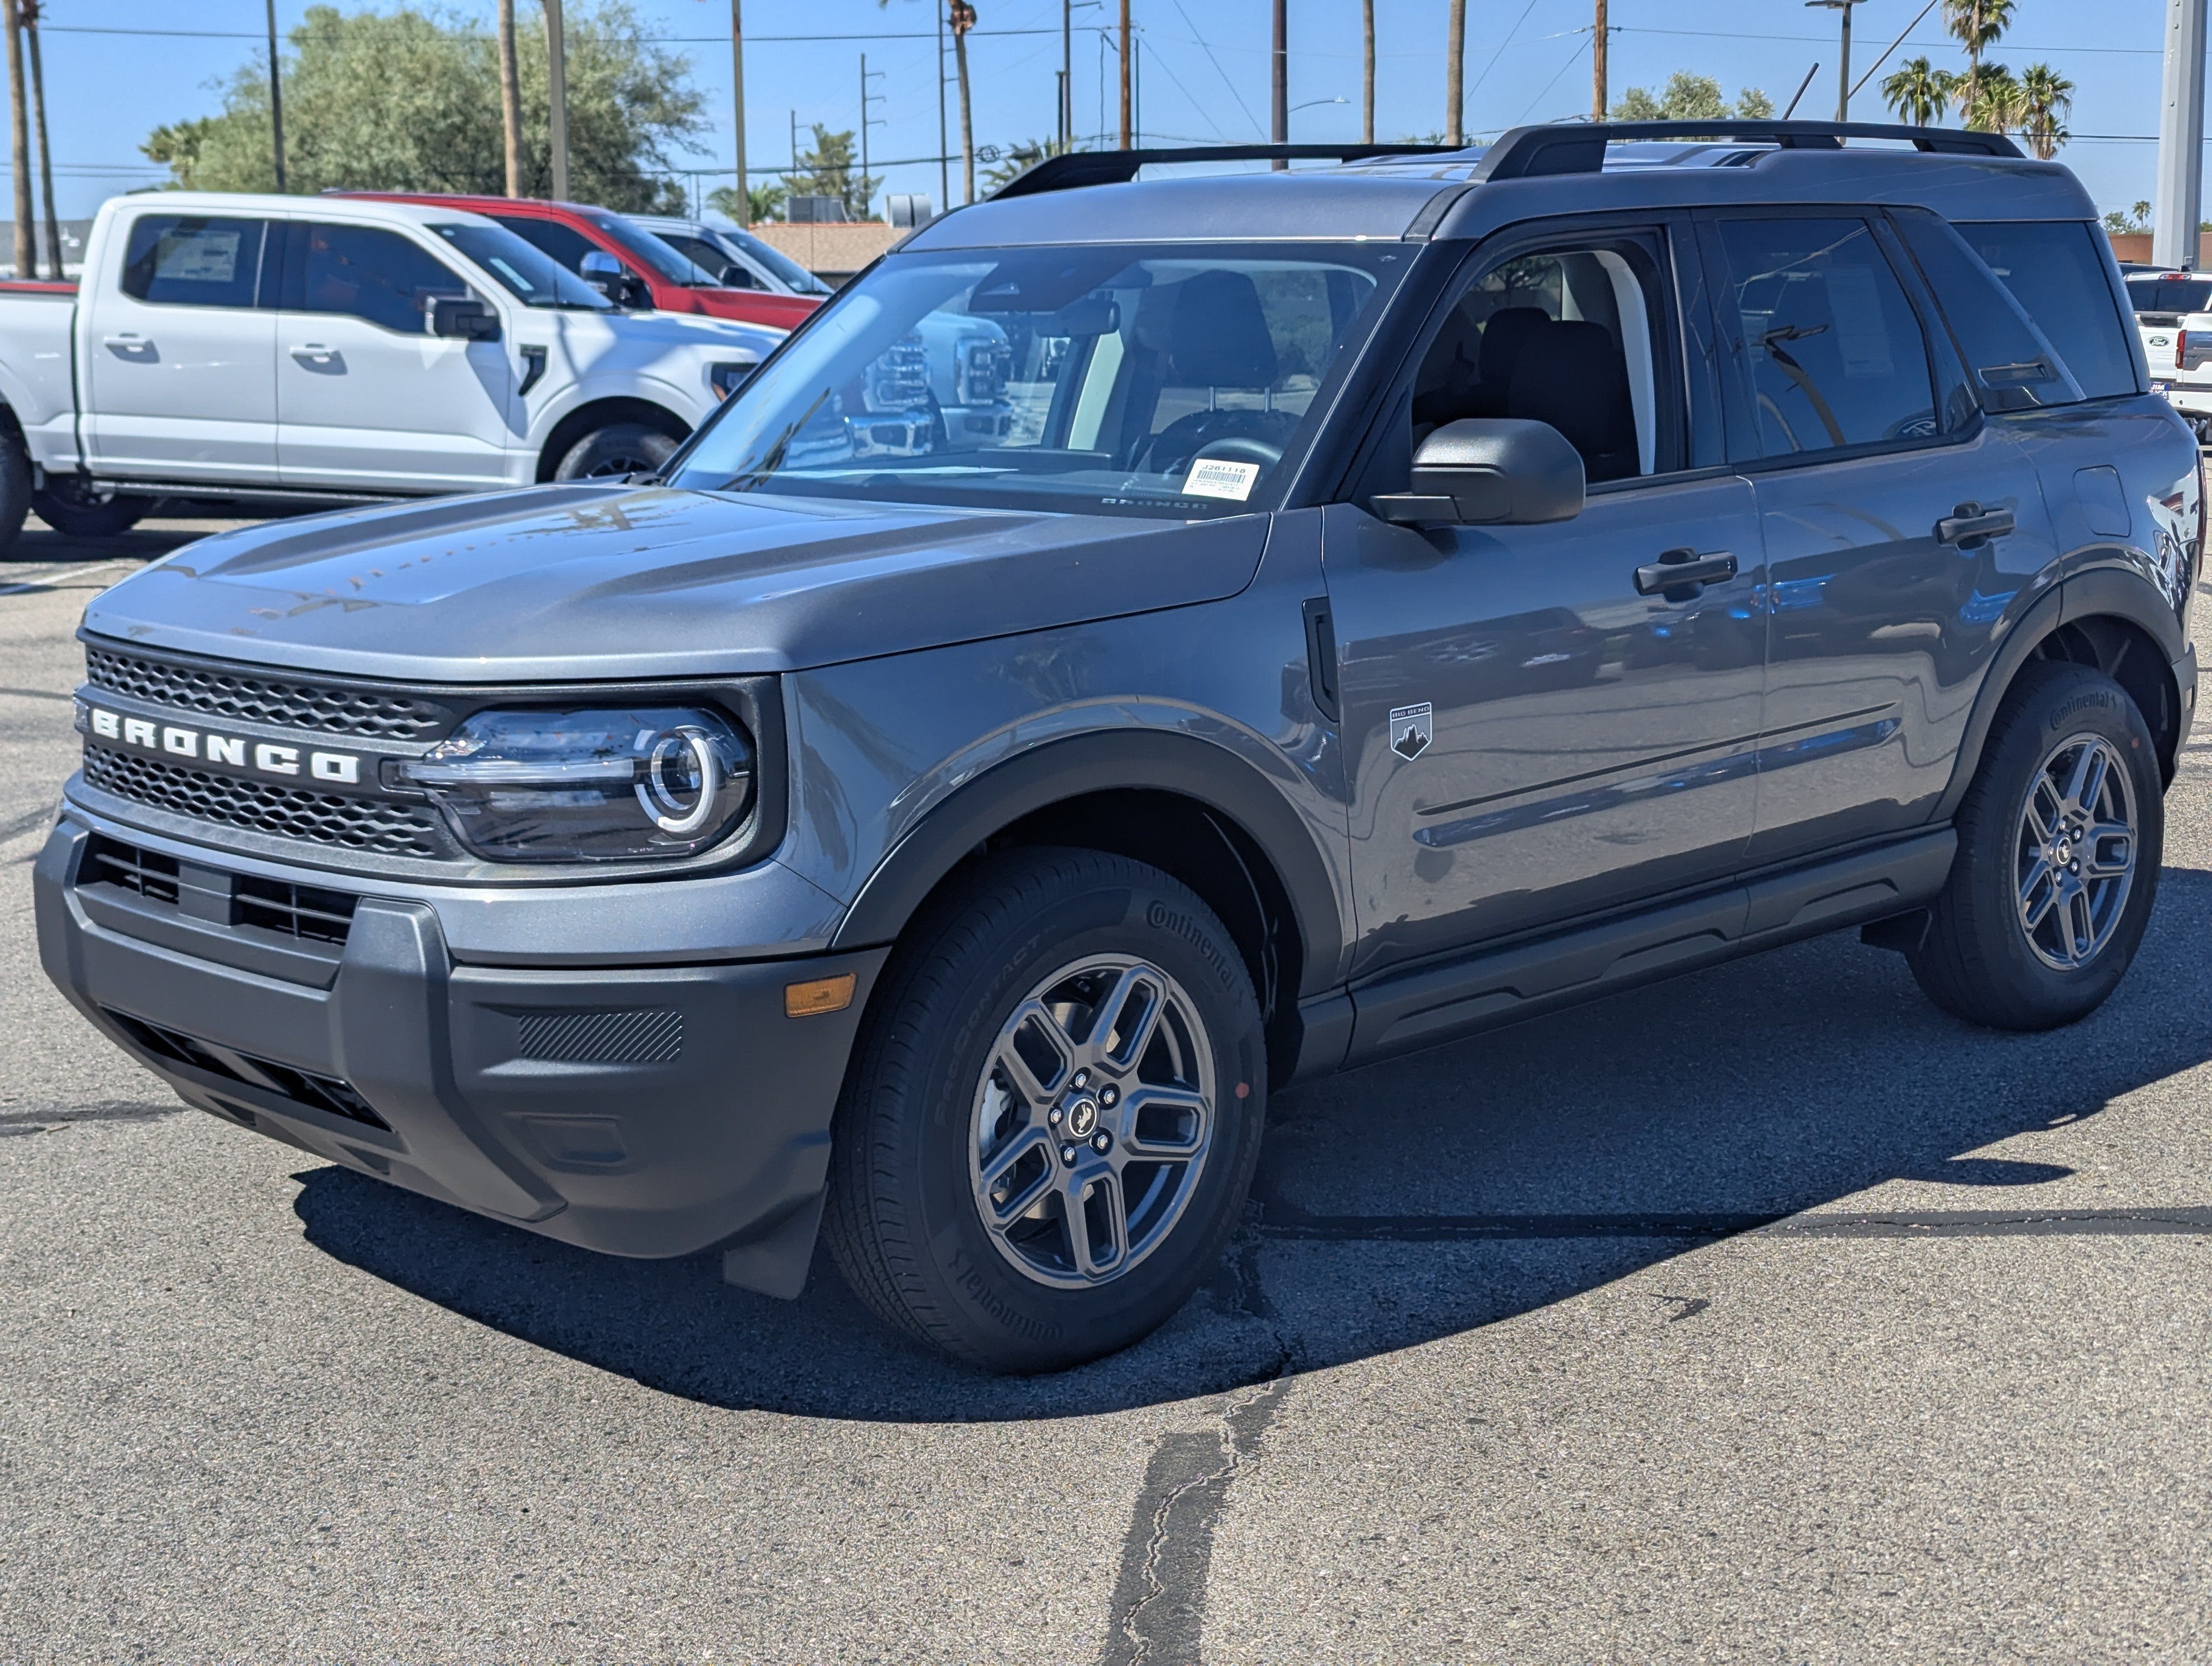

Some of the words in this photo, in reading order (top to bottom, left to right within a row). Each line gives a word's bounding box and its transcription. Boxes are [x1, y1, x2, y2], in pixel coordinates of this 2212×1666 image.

[1202, 465, 1246, 473] J261118
[1407, 706, 1430, 715] BEND
[2049, 691, 2108, 731] Continental
[92, 708, 360, 784] BRONCO
[1146, 899, 1238, 992] Continental
[956, 1265, 1065, 1341] Continental
